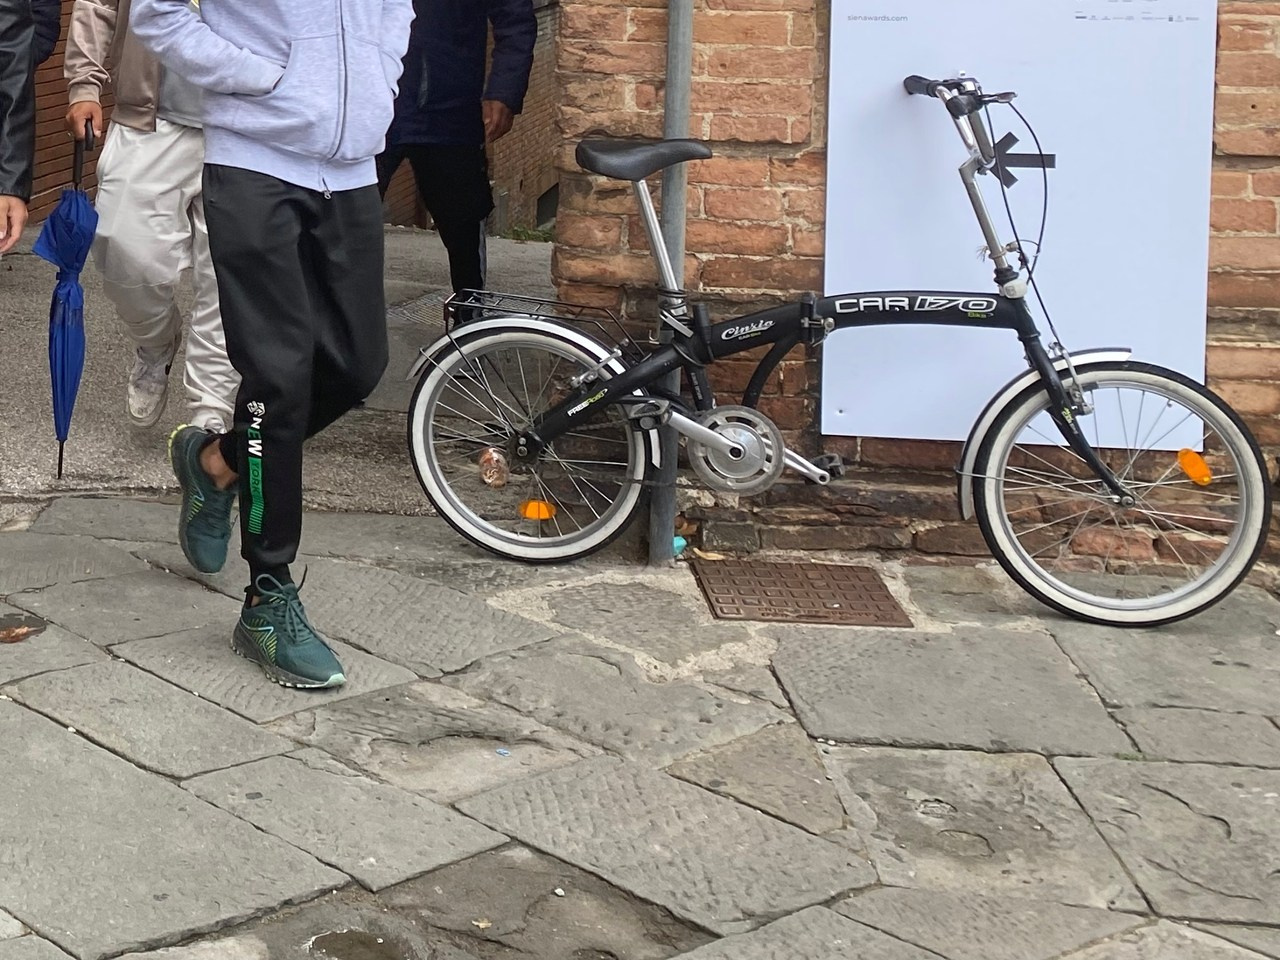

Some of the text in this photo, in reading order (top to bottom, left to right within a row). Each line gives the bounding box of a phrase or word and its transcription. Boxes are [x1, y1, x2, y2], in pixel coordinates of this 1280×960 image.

[835, 296, 910, 313] CAR
[247, 417, 263, 457] NEW
[251, 461, 262, 498] YORK
